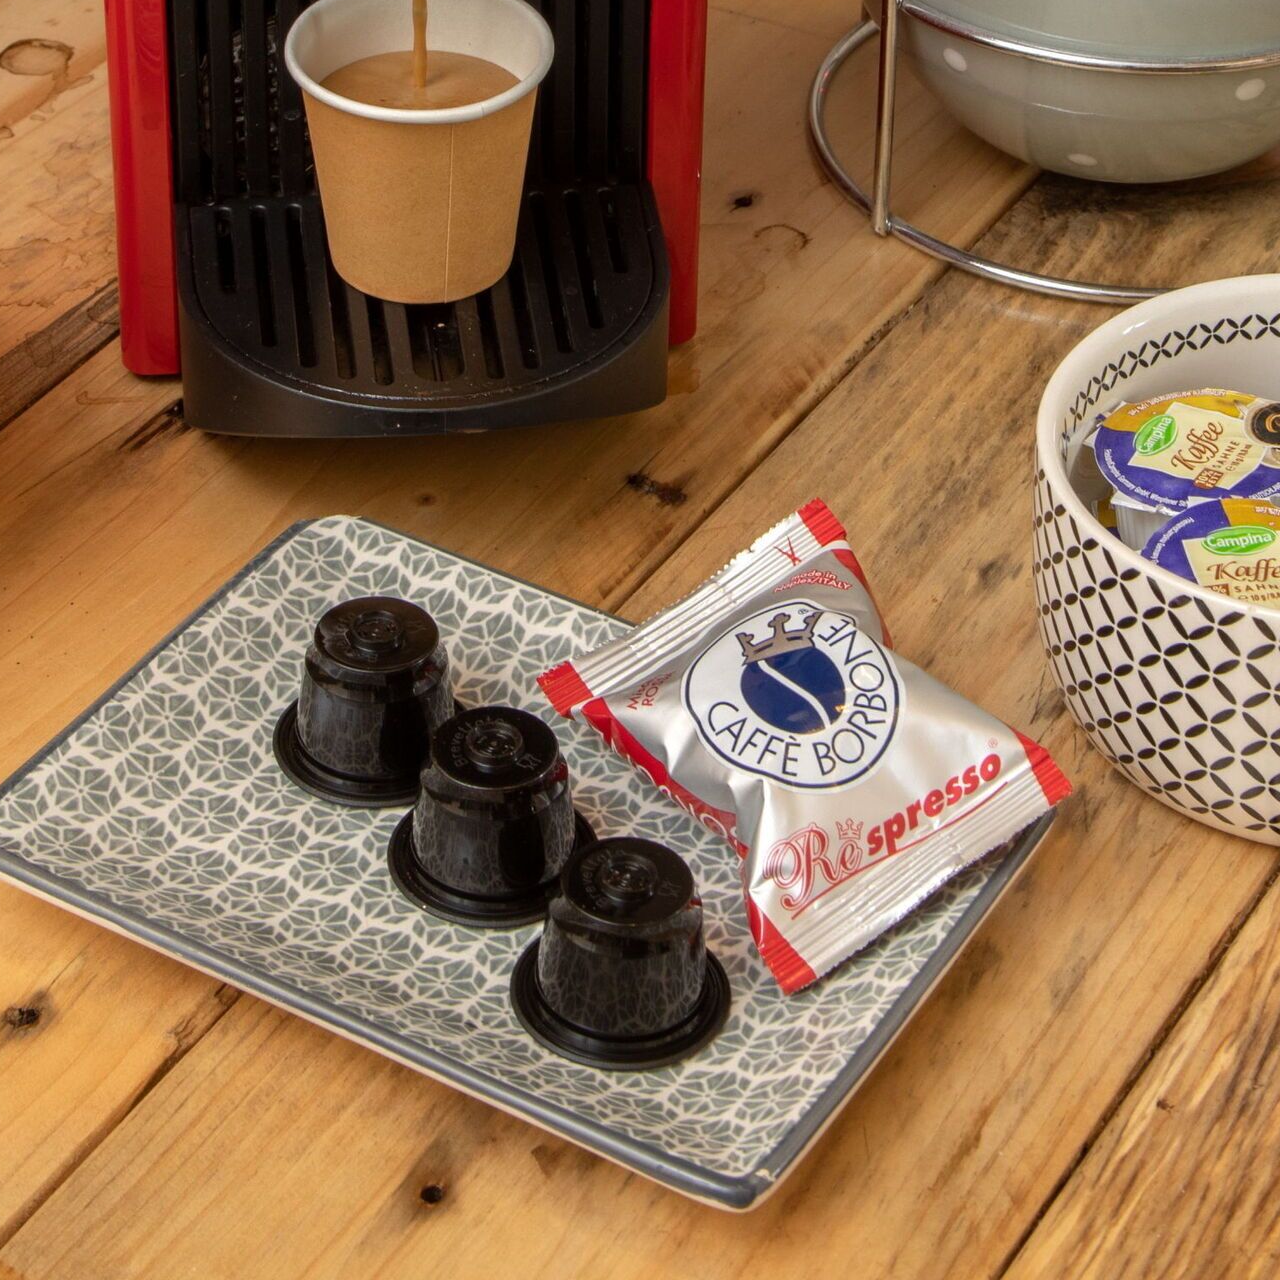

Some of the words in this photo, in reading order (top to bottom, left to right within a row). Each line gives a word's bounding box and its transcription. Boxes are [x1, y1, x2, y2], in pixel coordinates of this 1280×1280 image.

[1138, 417, 1173, 453] Campina
[1171, 421, 1223, 470] Kaffee
[1207, 533, 1272, 548] Campina
[708, 701, 801, 777] CAFFÈ
[812, 619, 888, 776] BORBONE
